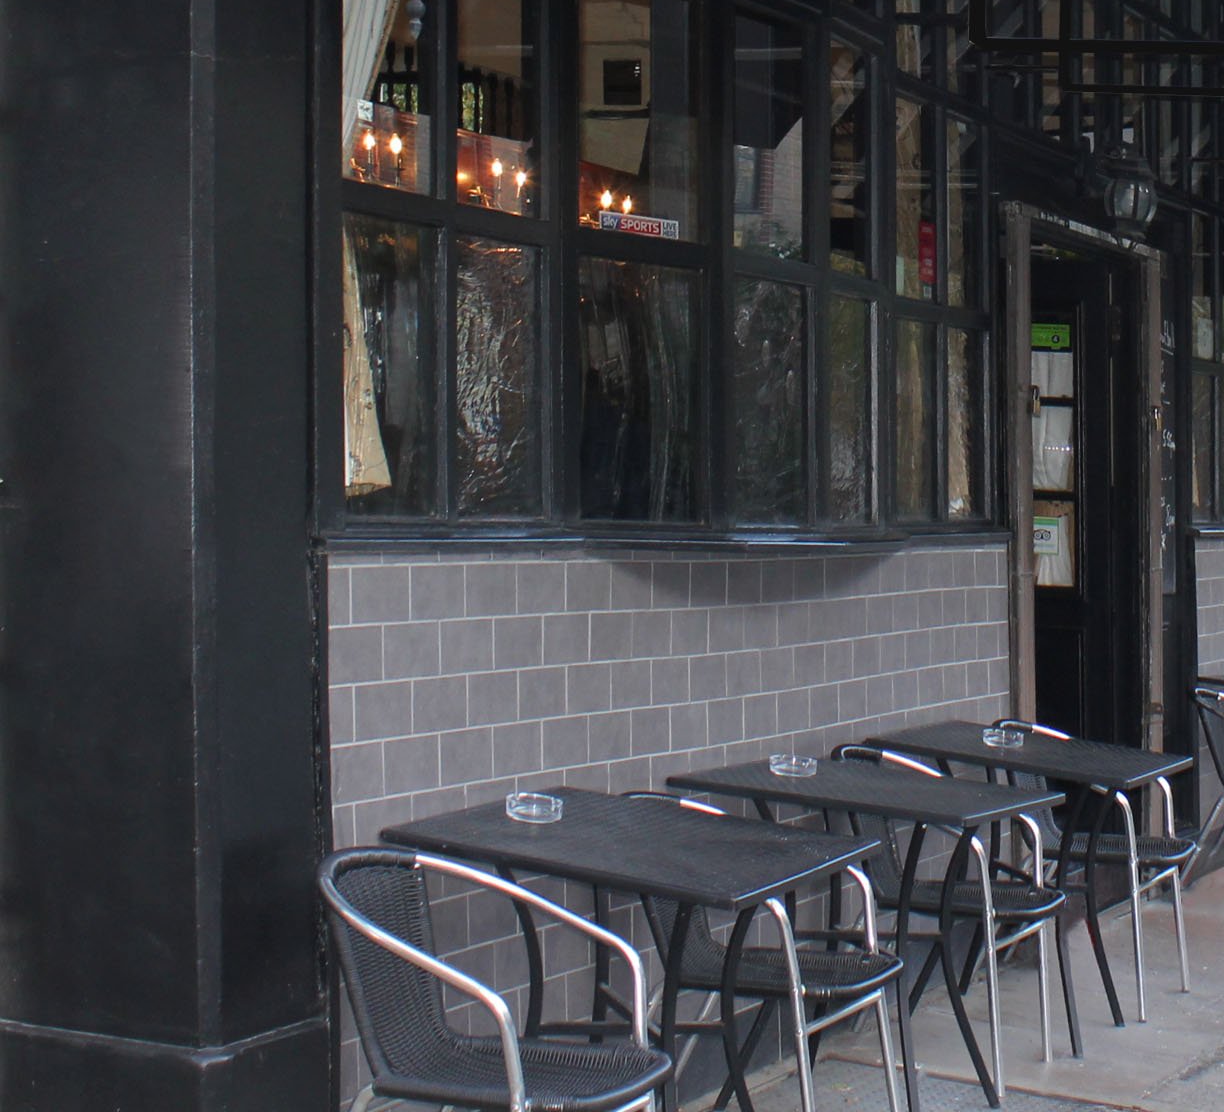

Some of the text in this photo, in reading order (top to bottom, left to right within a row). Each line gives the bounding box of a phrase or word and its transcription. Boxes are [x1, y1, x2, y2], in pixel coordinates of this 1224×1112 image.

[603, 216, 660, 233] sky SPORTS
[662, 221, 677, 231] LIVE
